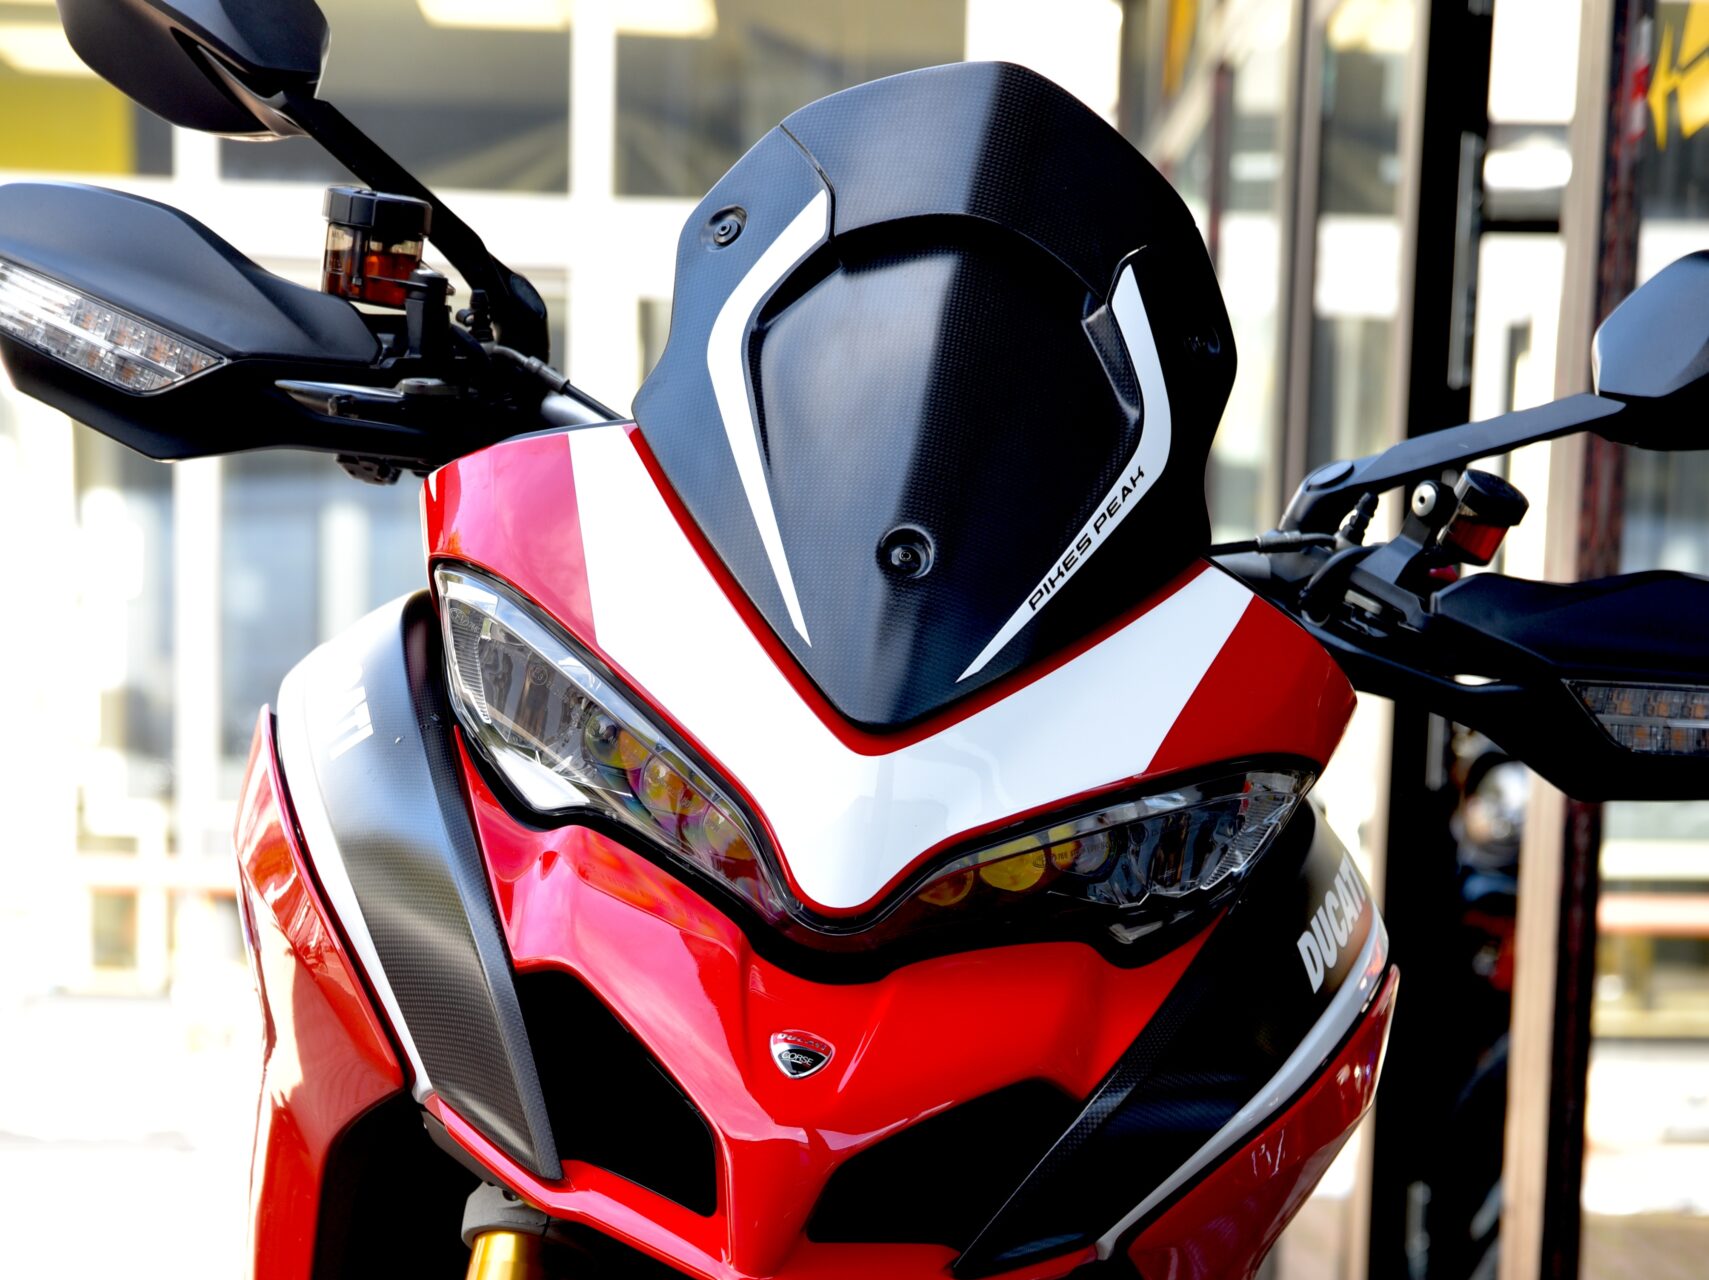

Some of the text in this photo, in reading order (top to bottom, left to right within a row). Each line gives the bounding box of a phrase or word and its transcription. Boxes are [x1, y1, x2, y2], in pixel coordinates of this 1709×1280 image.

[1028, 465, 1145, 612] PIKES PEAK
[781, 1050, 814, 1067] CORSE
